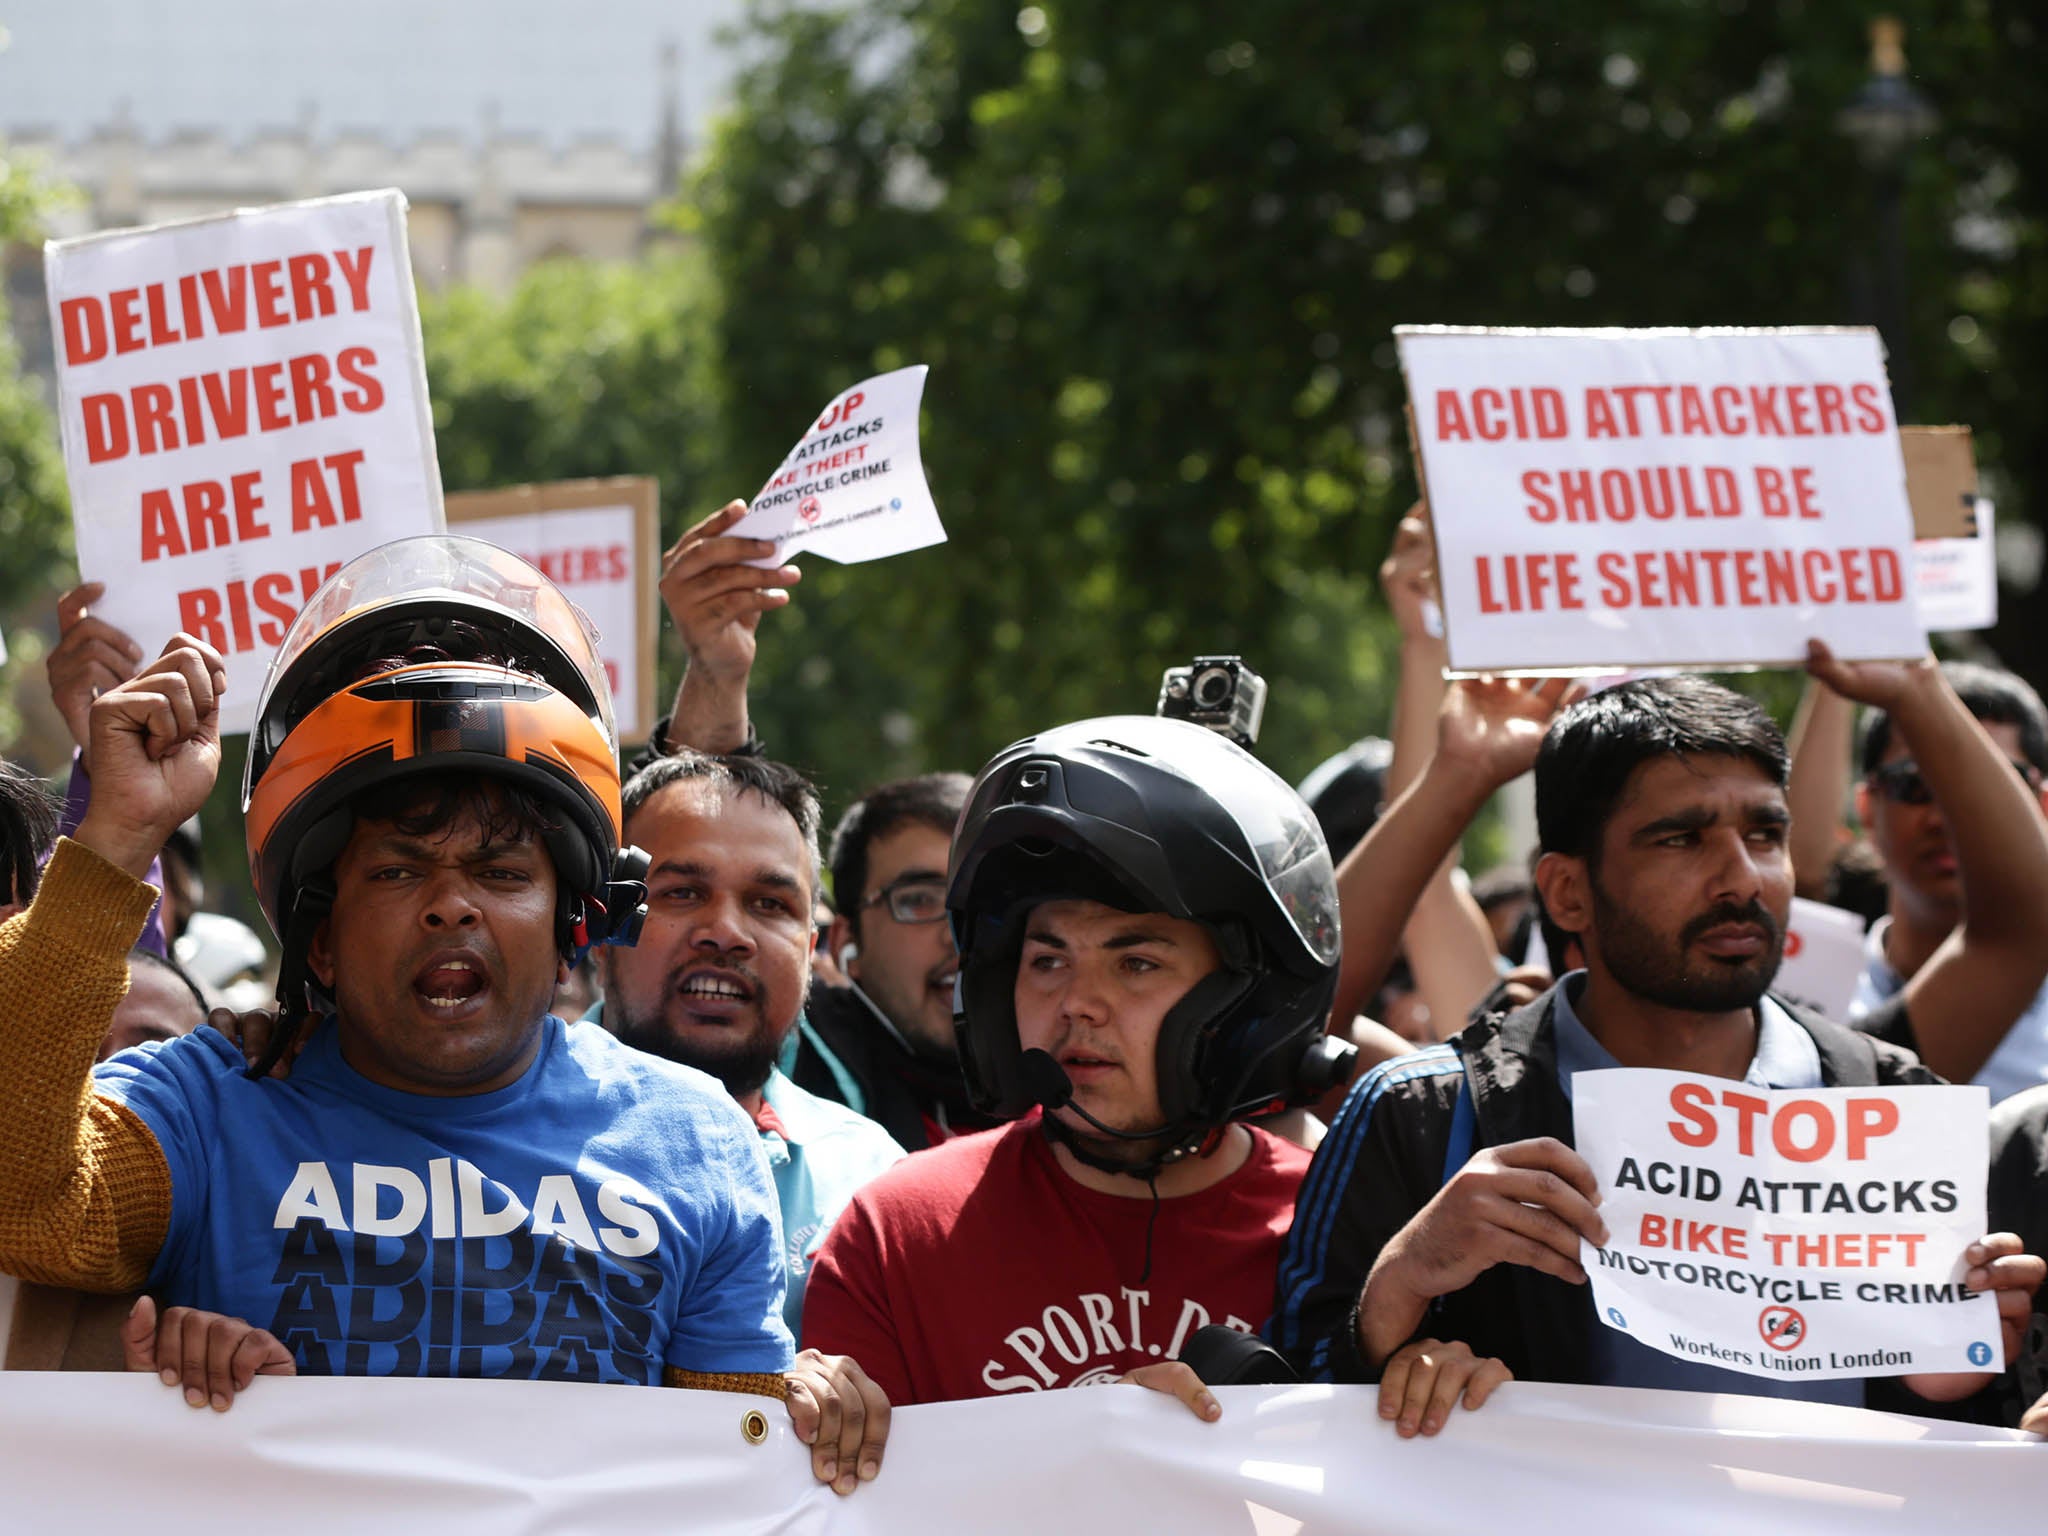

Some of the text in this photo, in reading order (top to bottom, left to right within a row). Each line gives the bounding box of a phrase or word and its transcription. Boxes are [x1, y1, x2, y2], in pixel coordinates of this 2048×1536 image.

[61, 247, 375, 367] DELIVERY
[81, 347, 385, 464] DRIVERS
[818, 392, 865, 431] OP
[1437, 383, 1885, 441] ACID ATTACKERS
[795, 417, 883, 462] ATTACKS
[806, 443, 868, 478] THEFT
[141, 450, 364, 562] ARE AT
[754, 458, 892, 513] TORCYCLE CRIME
[1521, 466, 1822, 523] SHOULD BE
[1475, 554, 1585, 614] LIFE
[1597, 547, 1903, 608] SENTENCED
[1668, 1083, 1899, 1162] STOP
[273, 1157, 660, 1258] ADIDAS
[1615, 1157, 1957, 1214] ACID ATTACKS
[1639, 1213, 1926, 1267] BIKE THEFT
[1598, 1248, 1981, 1304] MOTORCYCLE CRIME
[1670, 1333, 1913, 1372] Workers Union London
